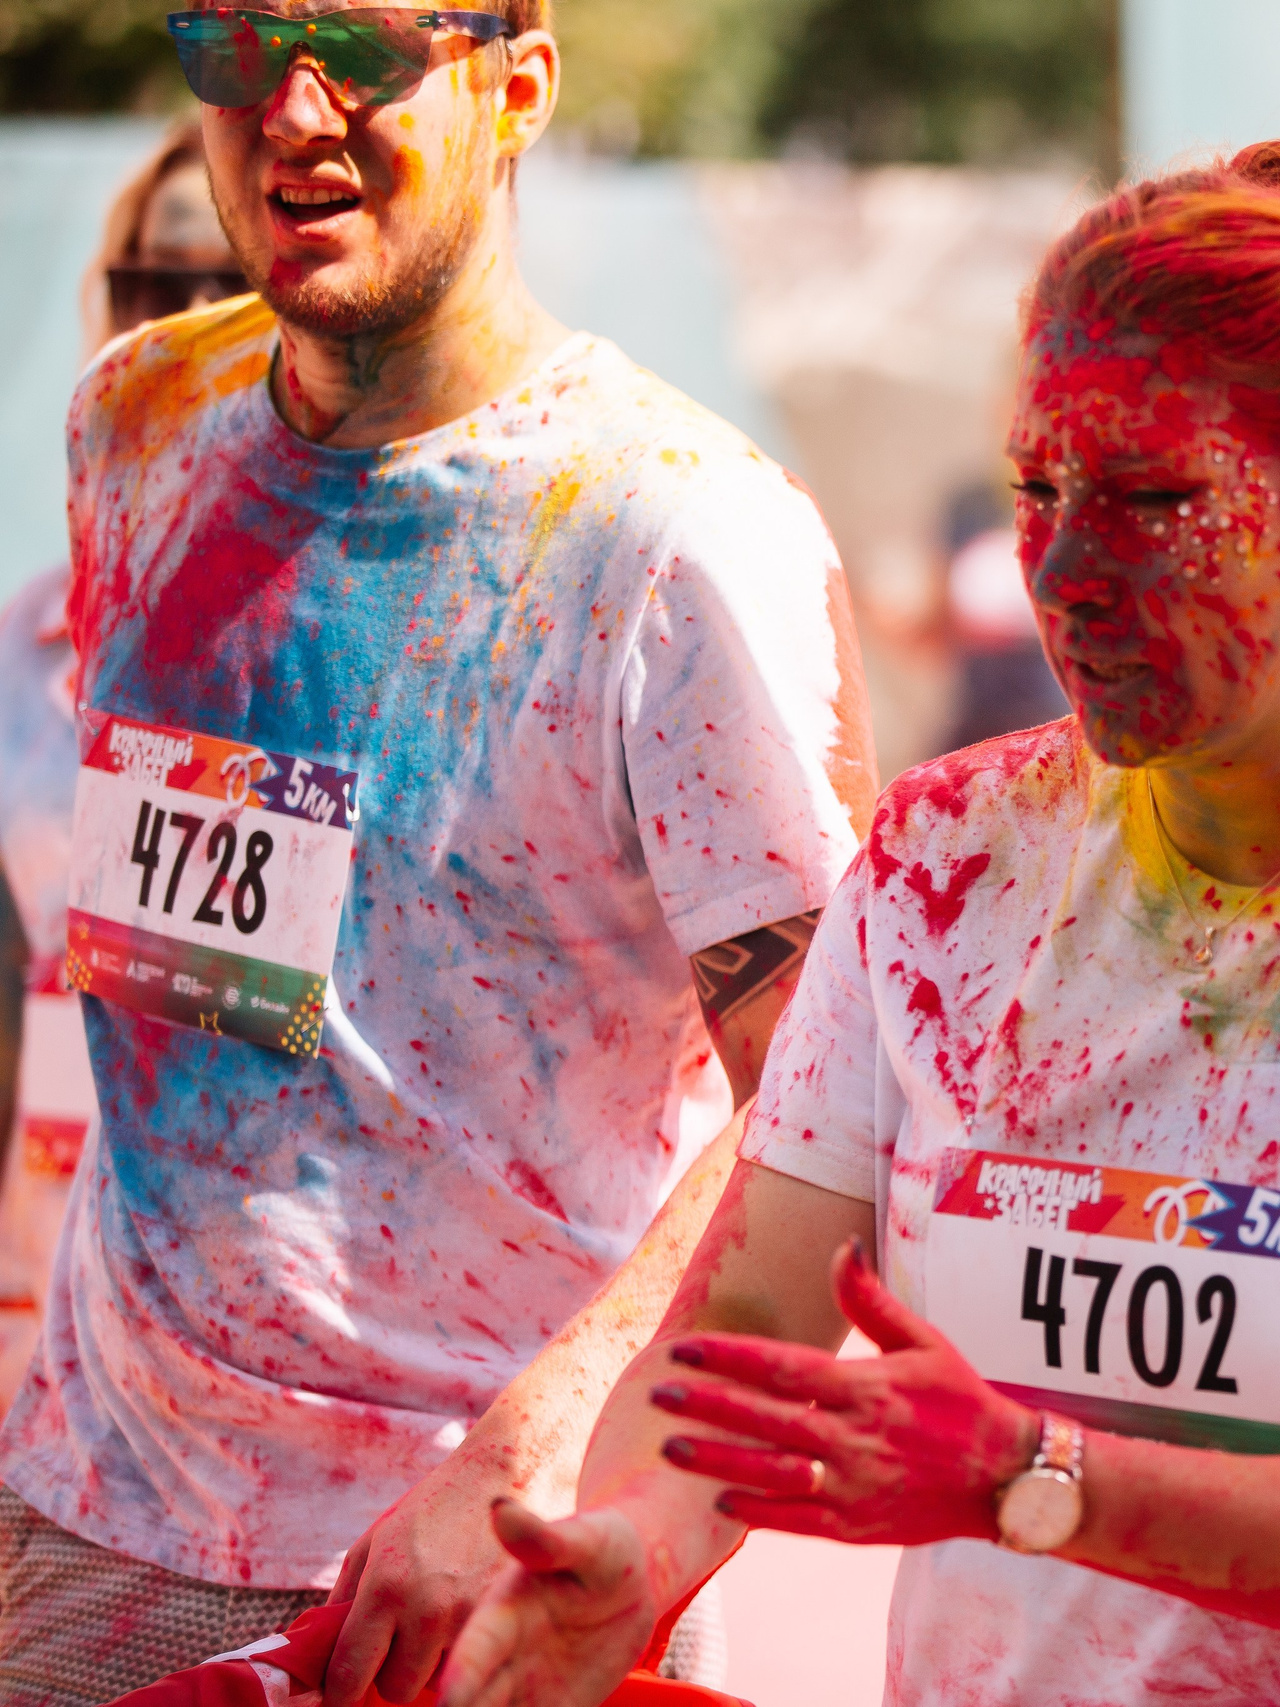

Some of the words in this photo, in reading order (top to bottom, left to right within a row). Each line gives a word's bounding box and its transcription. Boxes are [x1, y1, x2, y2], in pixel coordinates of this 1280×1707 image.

[131, 799, 274, 935] 4728
[976, 1159, 1102, 1204] КРАСОЧНЫЙ
[994, 1190, 1078, 1232] ЗАБЕГ
[1021, 1246, 1238, 1395] 4702
